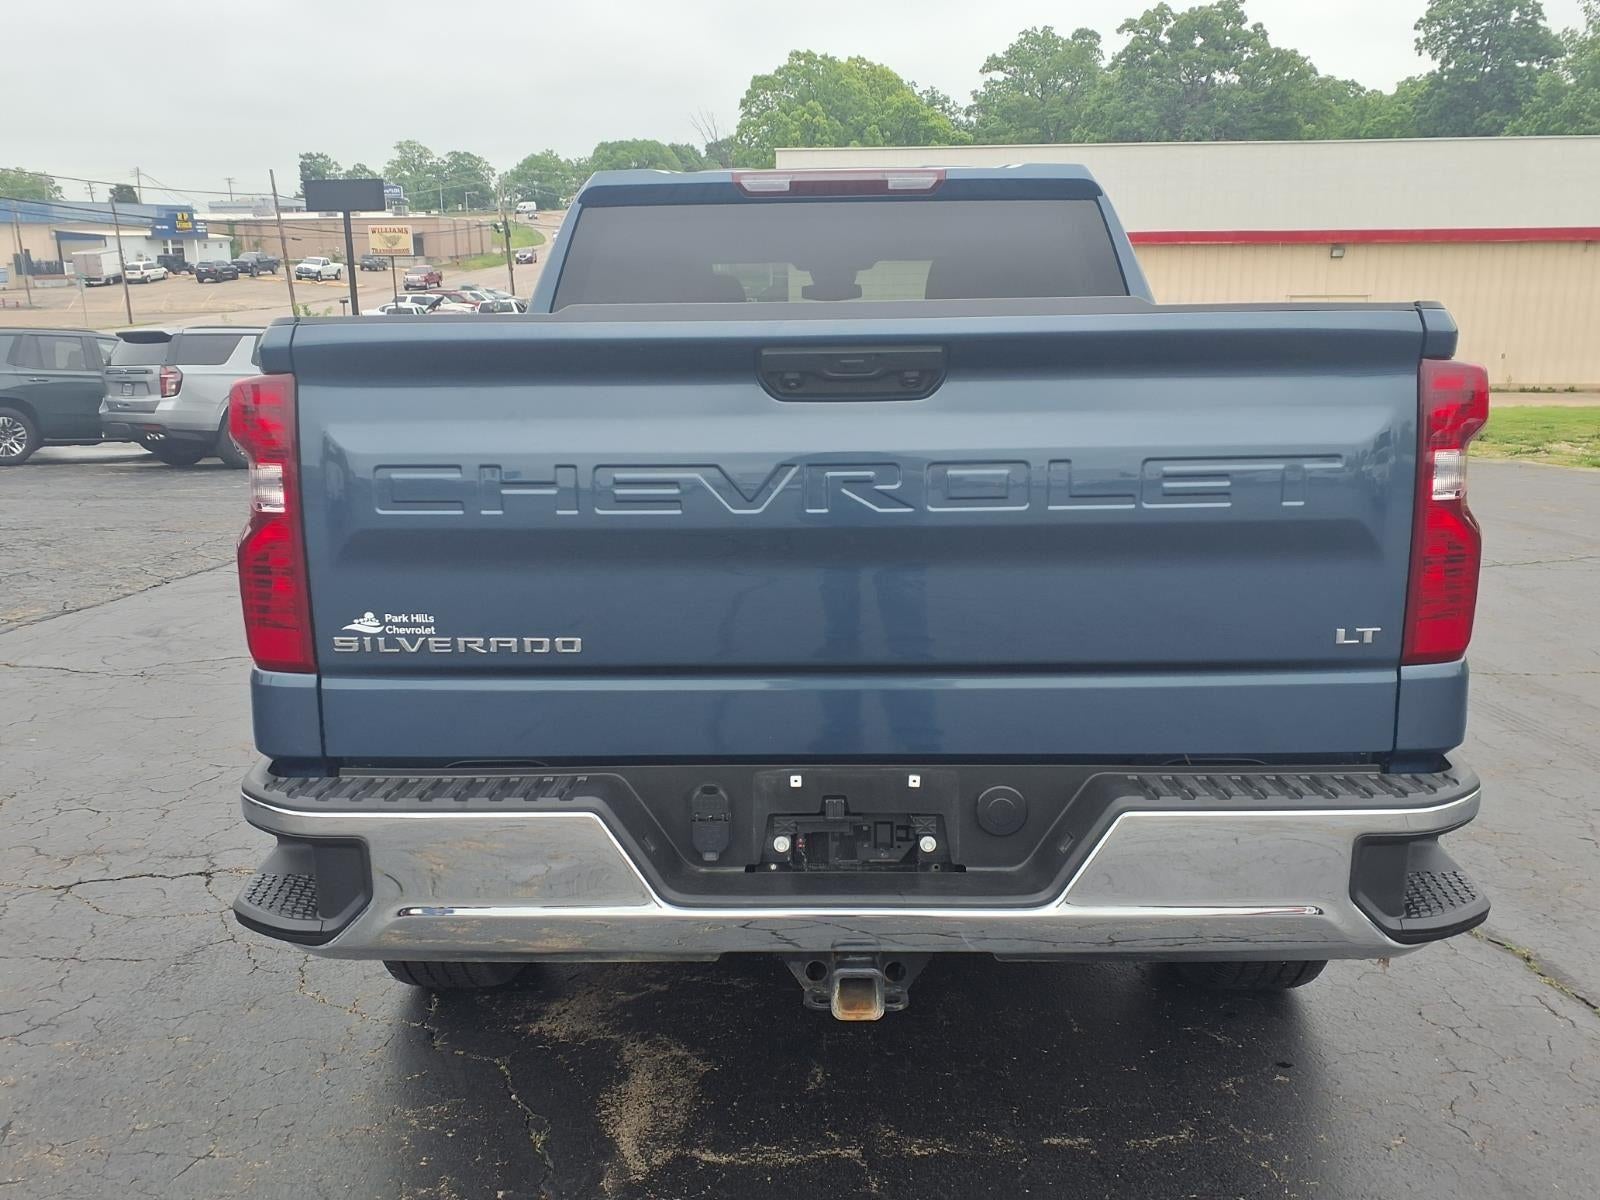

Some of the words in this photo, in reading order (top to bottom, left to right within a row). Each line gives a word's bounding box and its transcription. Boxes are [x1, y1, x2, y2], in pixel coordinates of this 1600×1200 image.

[371, 227, 409, 235] WILLIAMS
[373, 453, 1345, 515] CHEVROLET
[384, 613, 409, 623] Park
[411, 613, 435, 623] Hills
[385, 625, 436, 635] Chevrolet
[1335, 627, 1382, 645] LT
[332, 636, 583, 653] SILVERADO
